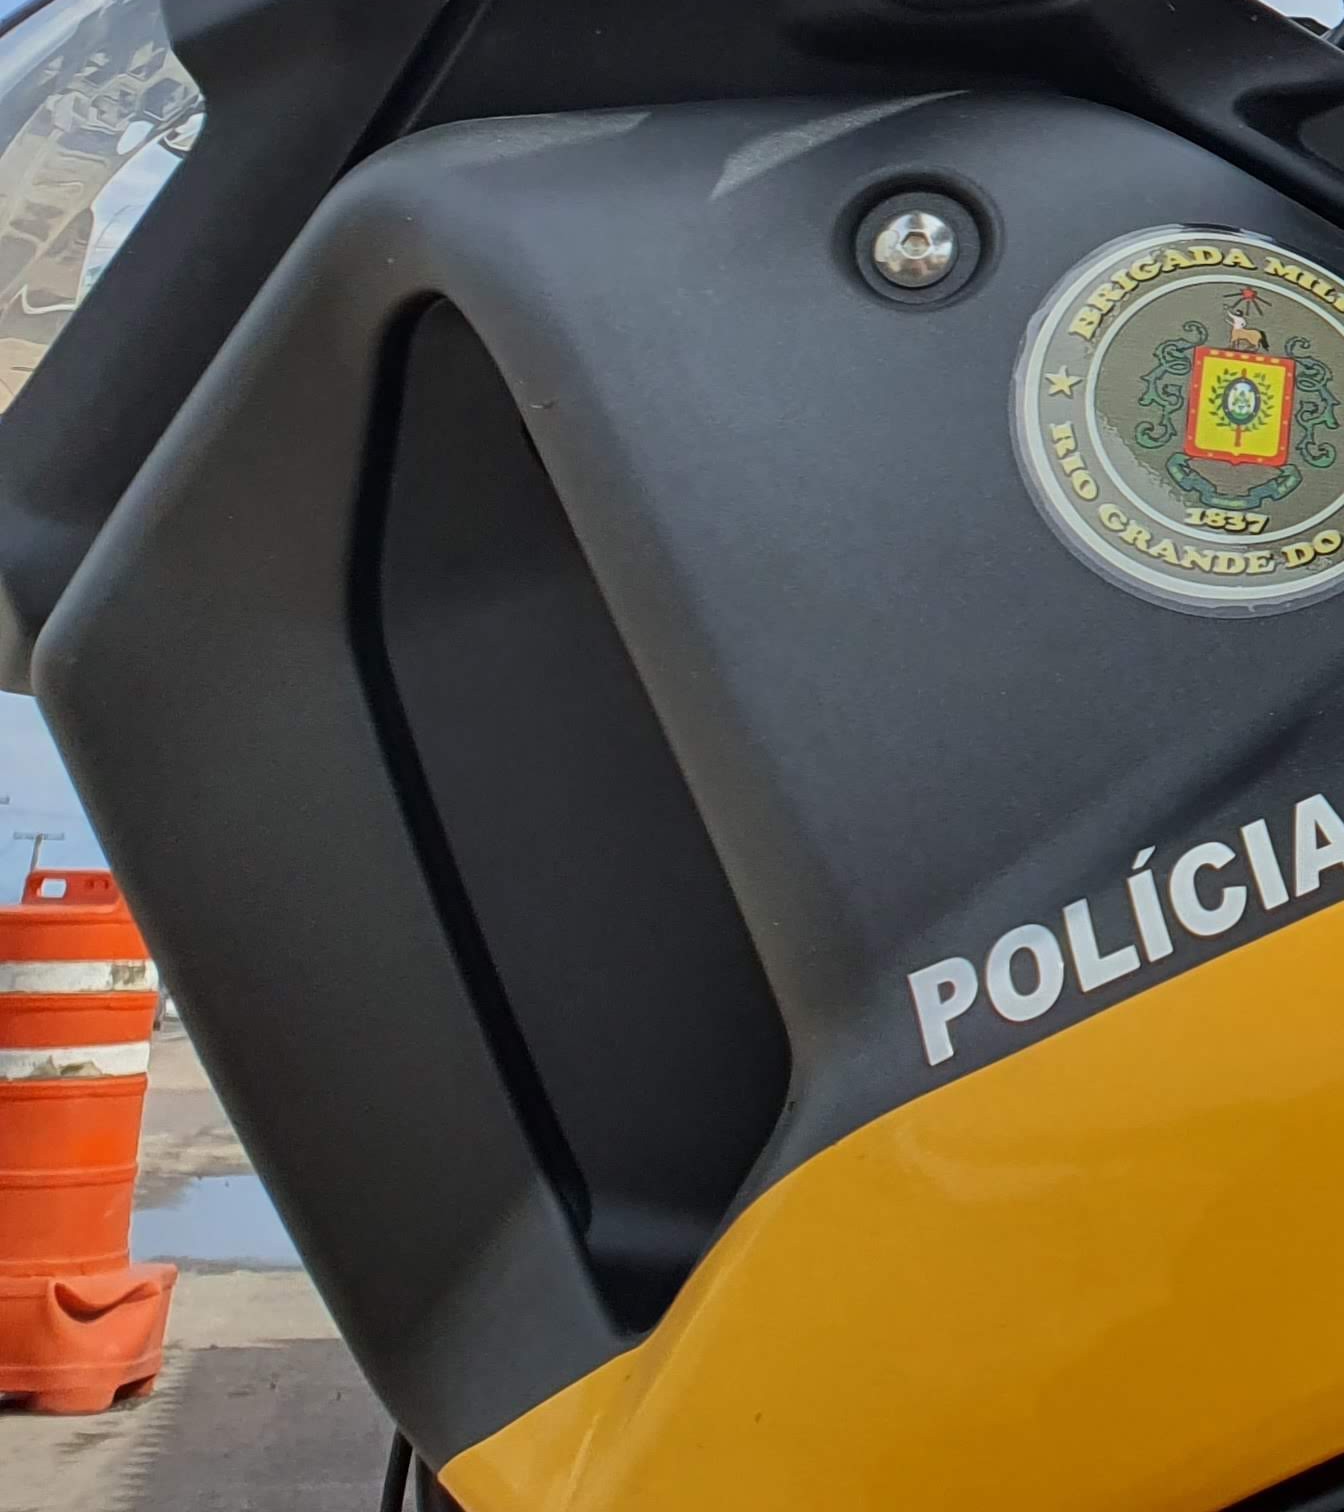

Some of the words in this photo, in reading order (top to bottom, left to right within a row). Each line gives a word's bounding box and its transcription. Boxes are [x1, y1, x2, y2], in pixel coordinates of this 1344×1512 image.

[1068, 245, 1258, 340] BRIGADA
[1050, 422, 1100, 502] RIO
[1099, 502, 1278, 576] GRANDE
[1282, 528, 1344, 569] DO
[1184, 507, 1270, 535] 1837
